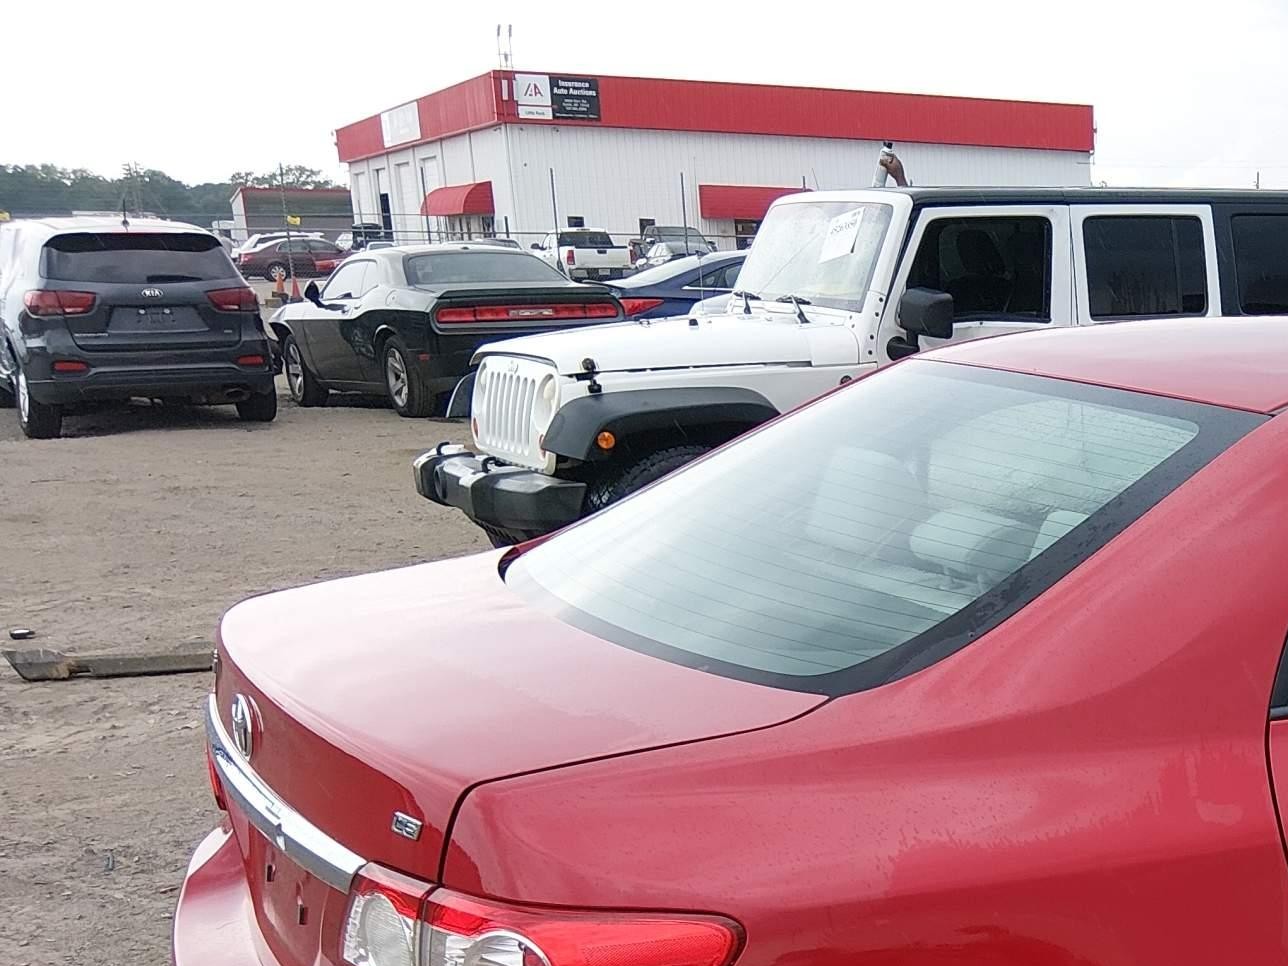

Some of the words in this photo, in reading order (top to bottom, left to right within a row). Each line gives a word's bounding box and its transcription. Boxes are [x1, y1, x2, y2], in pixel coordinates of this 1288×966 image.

[558, 80, 590, 88] Insurance
[553, 87, 568, 95] Auto
[569, 88, 597, 97] Auctions
[143, 288, 163, 297] KIA
[392, 811, 422, 840] LE
